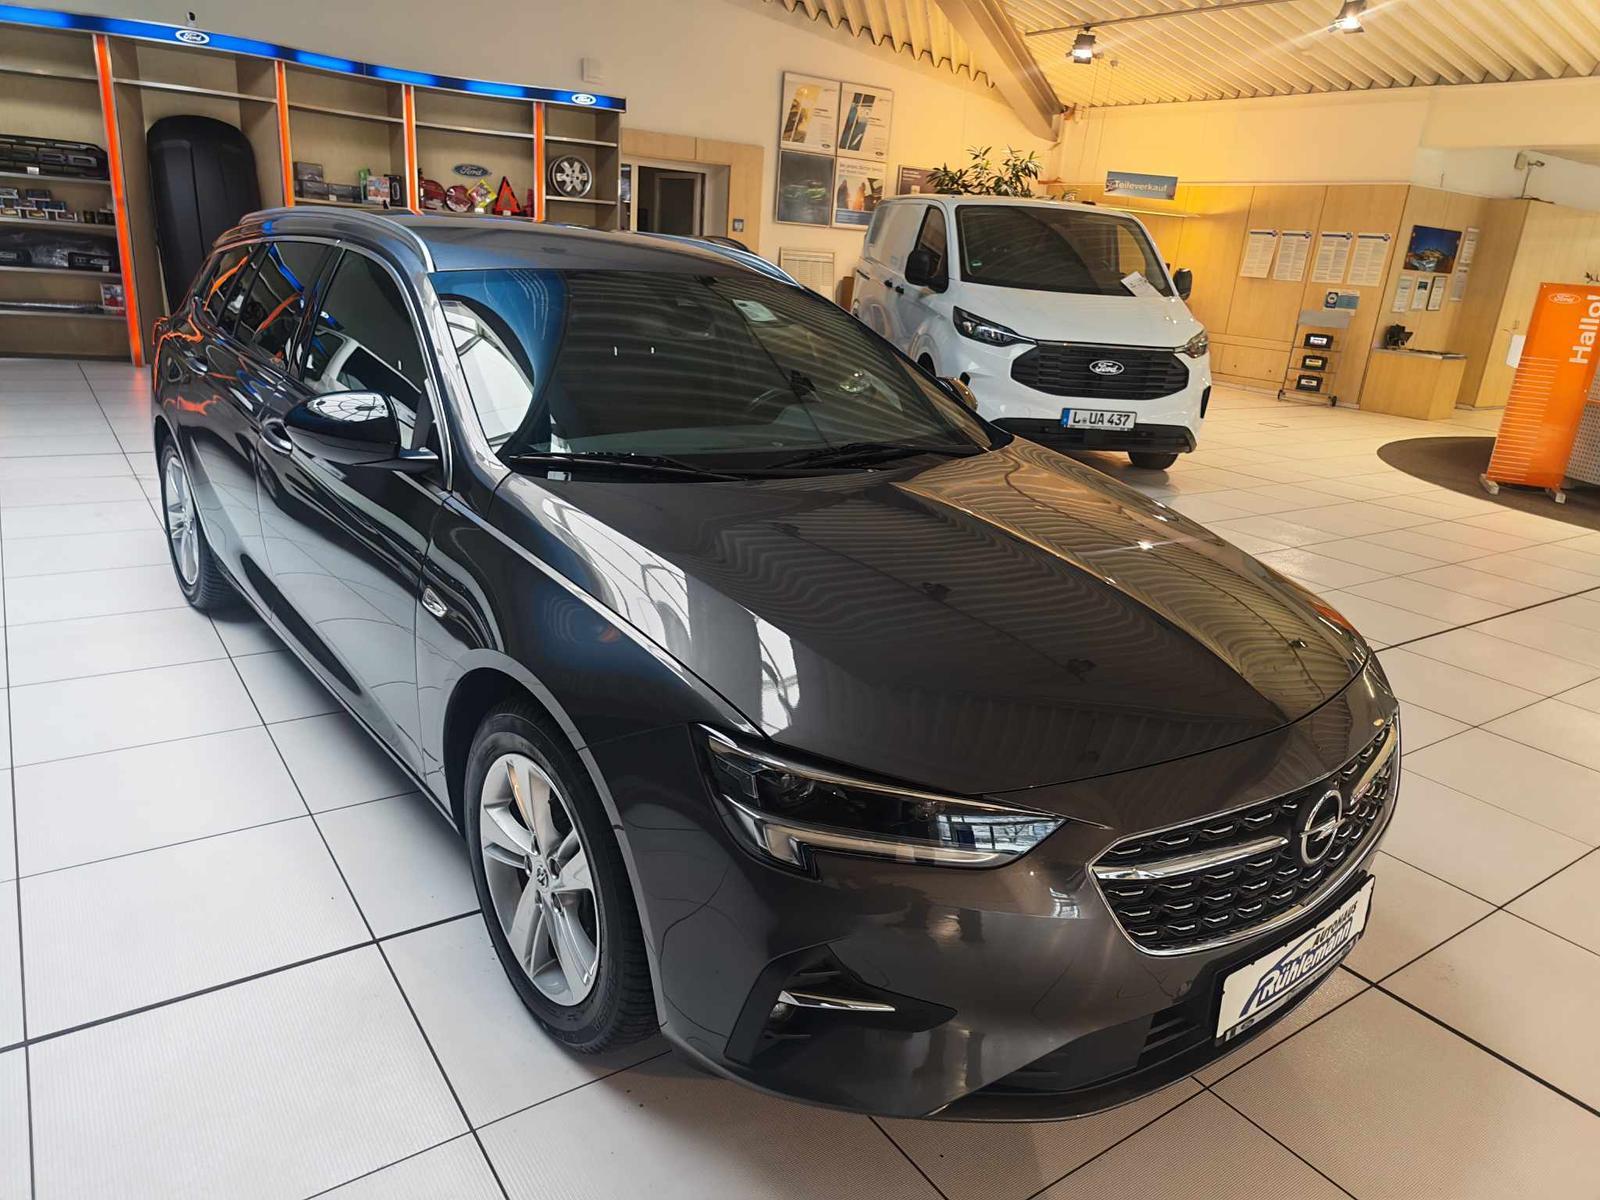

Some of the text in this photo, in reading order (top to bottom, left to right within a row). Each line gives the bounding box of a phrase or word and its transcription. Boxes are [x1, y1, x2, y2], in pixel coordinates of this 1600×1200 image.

[1114, 180, 1168, 193] Teileverkauf
[1094, 362, 1119, 373] Ford
[1088, 412, 1105, 425] UA
[1107, 413, 1131, 427] 437
[1312, 900, 1358, 947] AUTOHAUS
[1257, 919, 1352, 1002] Rühlemann
